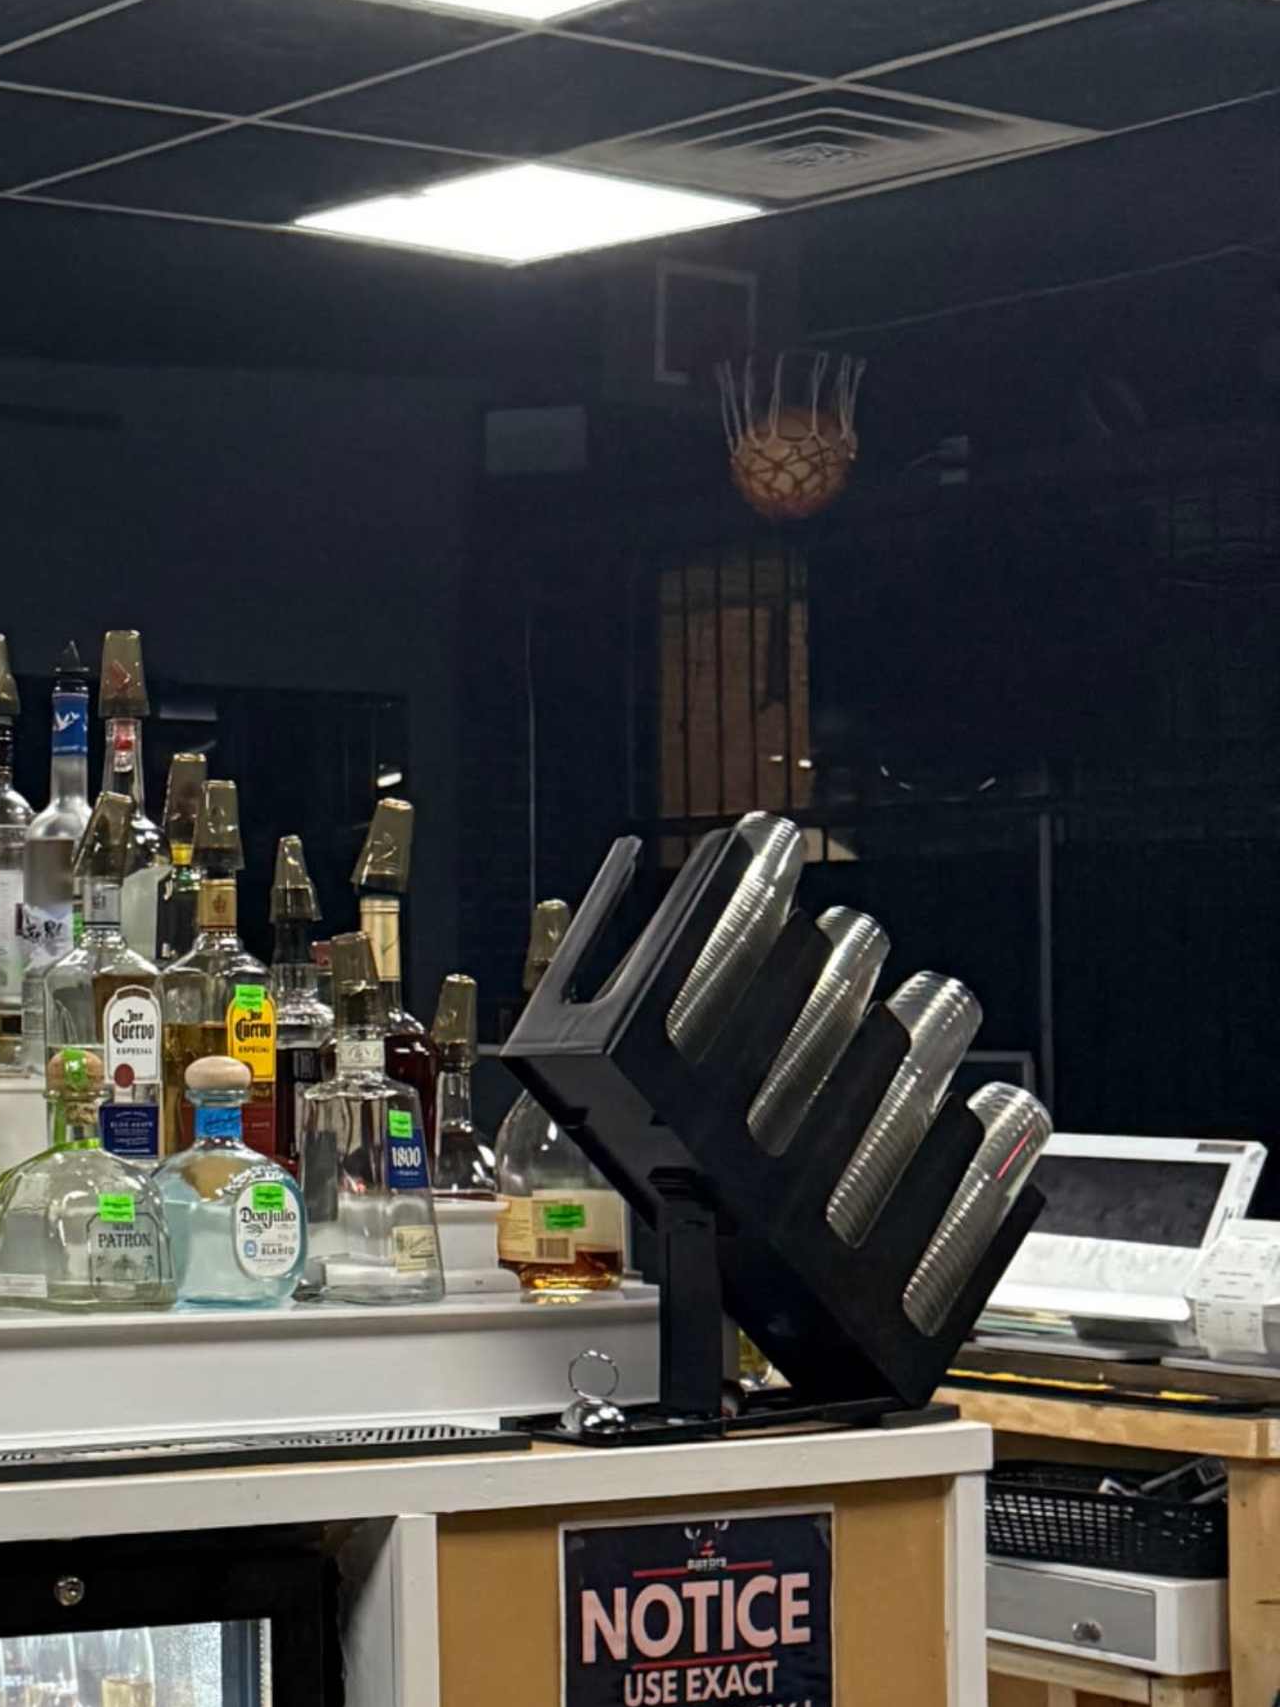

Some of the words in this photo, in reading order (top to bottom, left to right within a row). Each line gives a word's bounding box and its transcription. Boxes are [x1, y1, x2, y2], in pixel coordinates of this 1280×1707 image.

[112, 1017, 155, 1043] Cuervo
[235, 1017, 272, 1042] Cuervo
[391, 1146, 421, 1168] 1800
[581, 1573, 811, 1664] NOTICE
[623, 1670, 678, 1707] USE
[686, 1660, 779, 1702] EXACT
